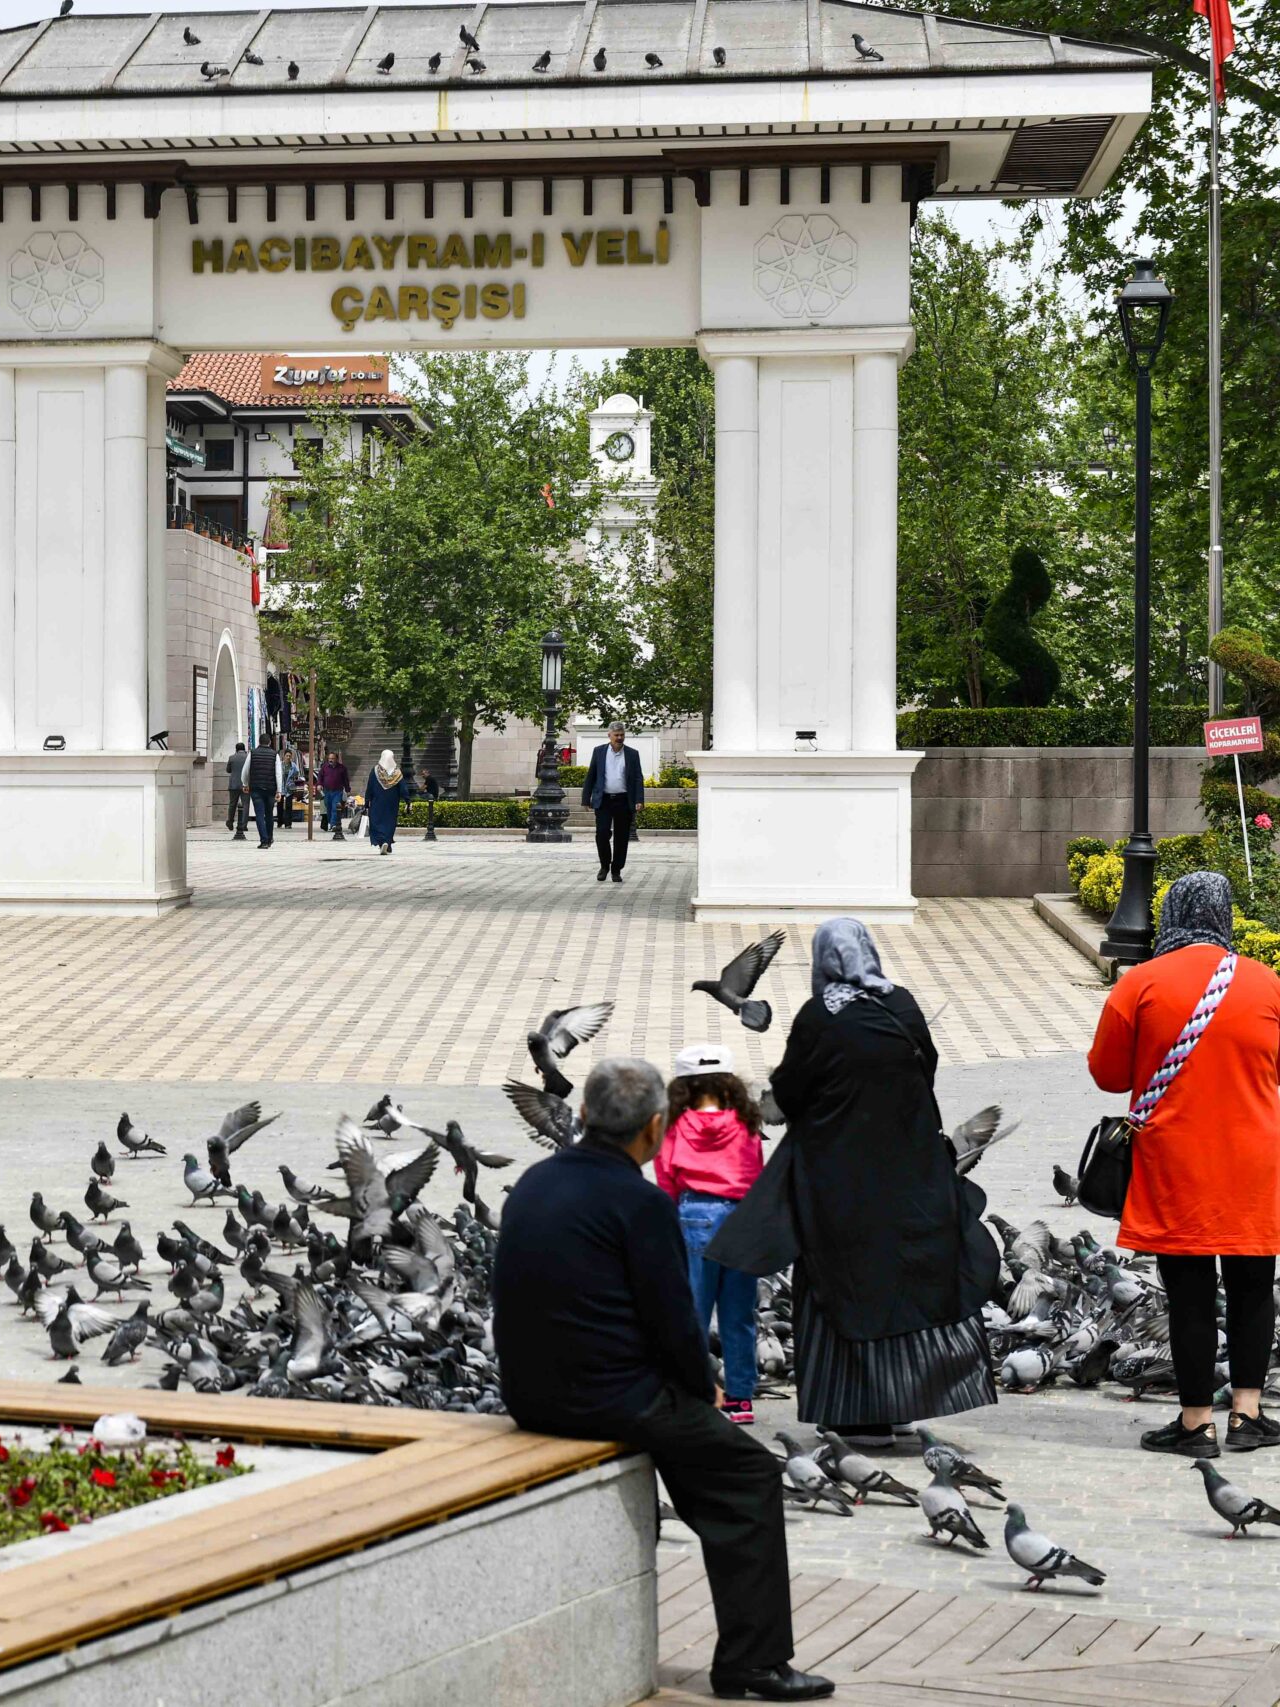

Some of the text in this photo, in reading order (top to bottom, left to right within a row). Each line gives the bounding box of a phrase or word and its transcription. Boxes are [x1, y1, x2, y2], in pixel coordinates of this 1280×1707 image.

[191, 220, 670, 273] HACIBAYRAM-I VELİ
[330, 282, 526, 332] ÇARŞISI
[1209, 722, 1257, 740] ÇİÇEKLERİ
[1209, 736, 1260, 749] KOPARMAYINIZ
